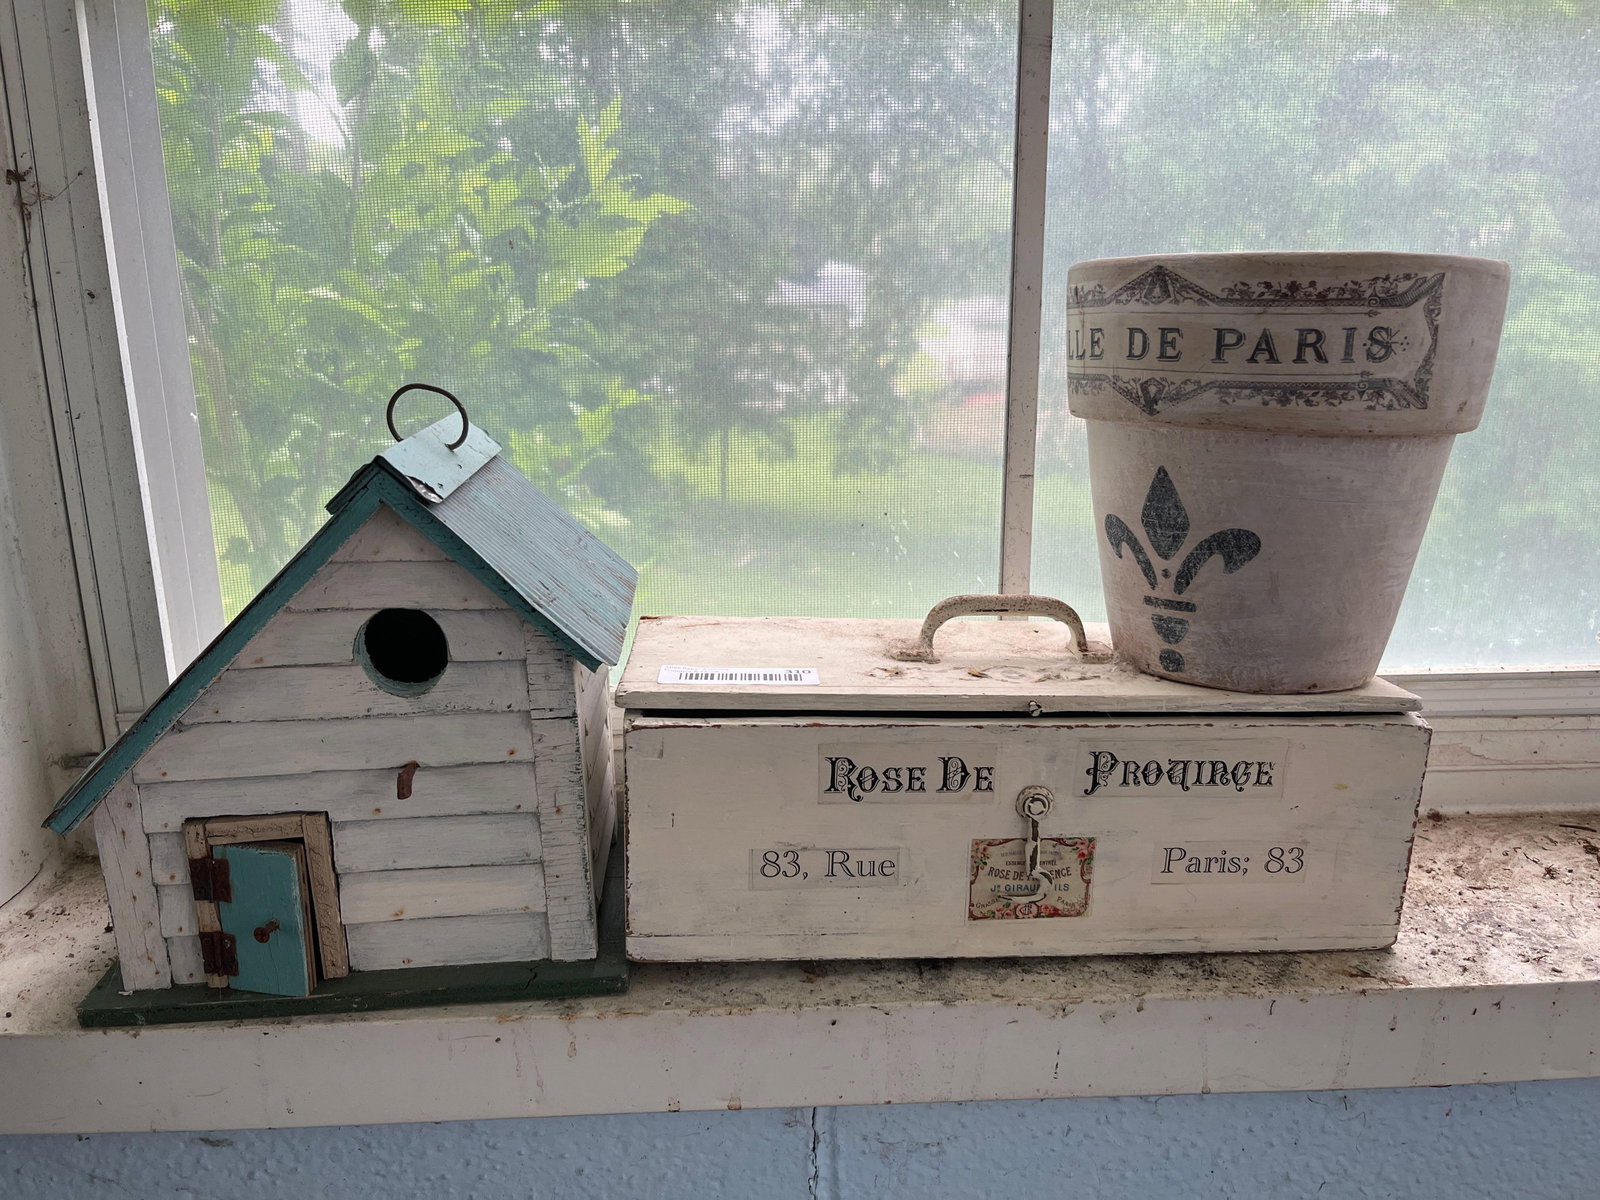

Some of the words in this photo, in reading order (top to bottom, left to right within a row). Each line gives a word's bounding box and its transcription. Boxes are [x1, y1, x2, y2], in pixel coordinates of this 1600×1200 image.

[1126, 327, 1183, 363] DE
[1211, 325, 1396, 365] PARIS
[760, 850, 808, 881] 83,
[824, 850, 896, 878] Rue
[988, 866, 1010, 880] ROSE
[1012, 870, 1025, 881] DE
[1160, 847, 1250, 876] Paris;
[1263, 846, 1305, 874] 83
